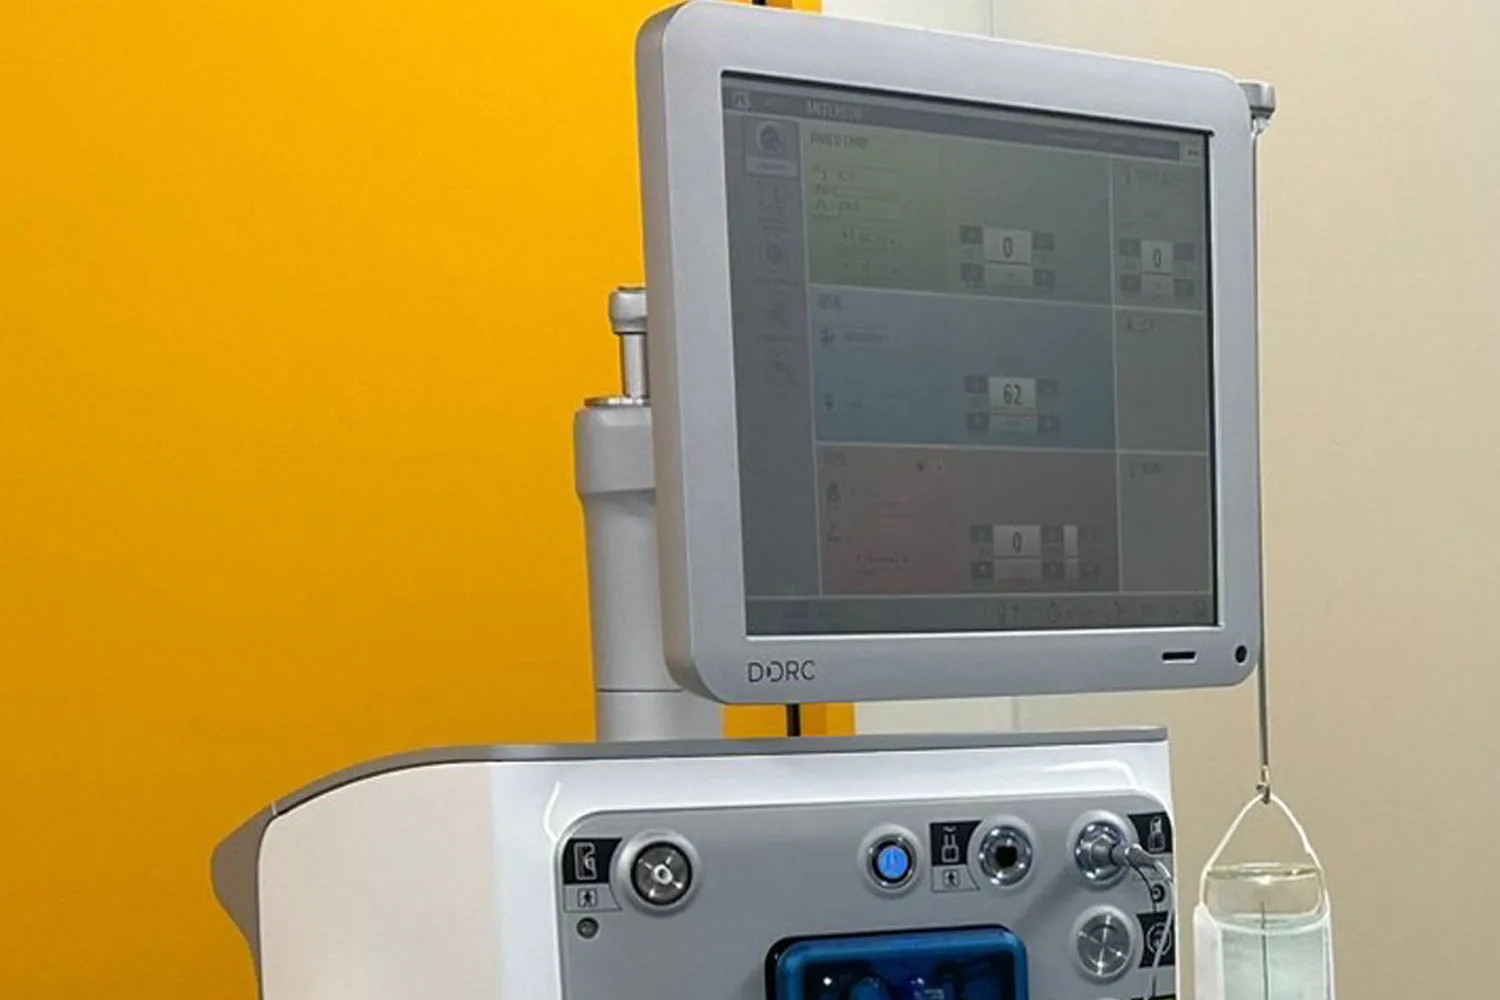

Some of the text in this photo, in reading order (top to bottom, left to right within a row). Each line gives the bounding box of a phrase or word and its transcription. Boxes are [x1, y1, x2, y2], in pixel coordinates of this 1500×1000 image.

[1003, 236, 1013, 258] 0
[1152, 248, 1161, 268] 0
[1003, 383, 1023, 406] 62
[1012, 532, 1022, 553] 0
